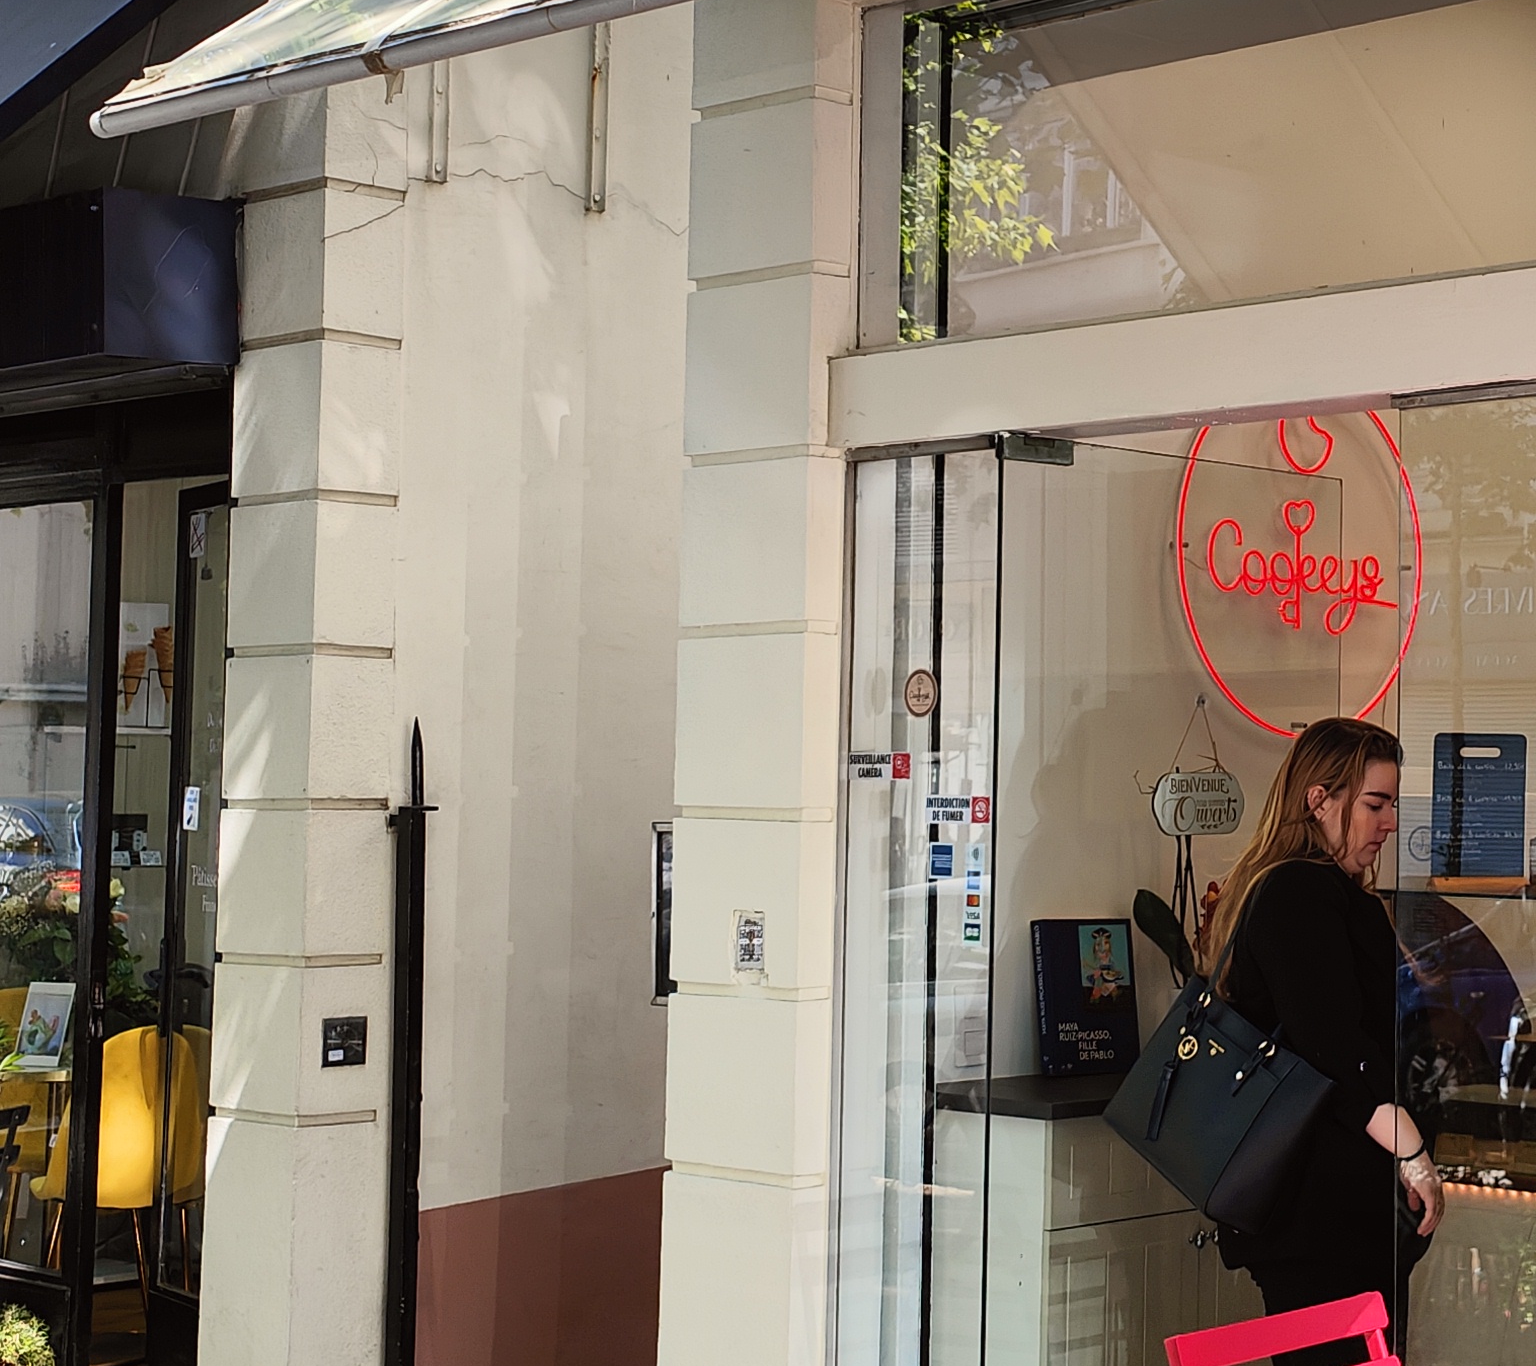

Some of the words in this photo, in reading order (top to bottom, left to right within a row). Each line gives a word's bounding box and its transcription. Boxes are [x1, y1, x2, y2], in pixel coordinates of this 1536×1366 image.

[1207, 500, 1398, 635] Cookeys
[850, 754, 891, 765] SURVEILLANCE
[858, 765, 883, 778] CAMÉRA
[1169, 776, 1230, 795] BIENVENUE
[926, 797, 970, 808] INTERDICTION
[932, 810, 940, 821] DE
[942, 810, 964, 821] FUMER
[1162, 795, 1238, 832] Ouverts
[1058, 1022, 1079, 1031] MAYA
[1079, 1040, 1098, 1050] FILLE
[1080, 1051, 1090, 1060] DE
[1090, 1049, 1115, 1060] PABLO
